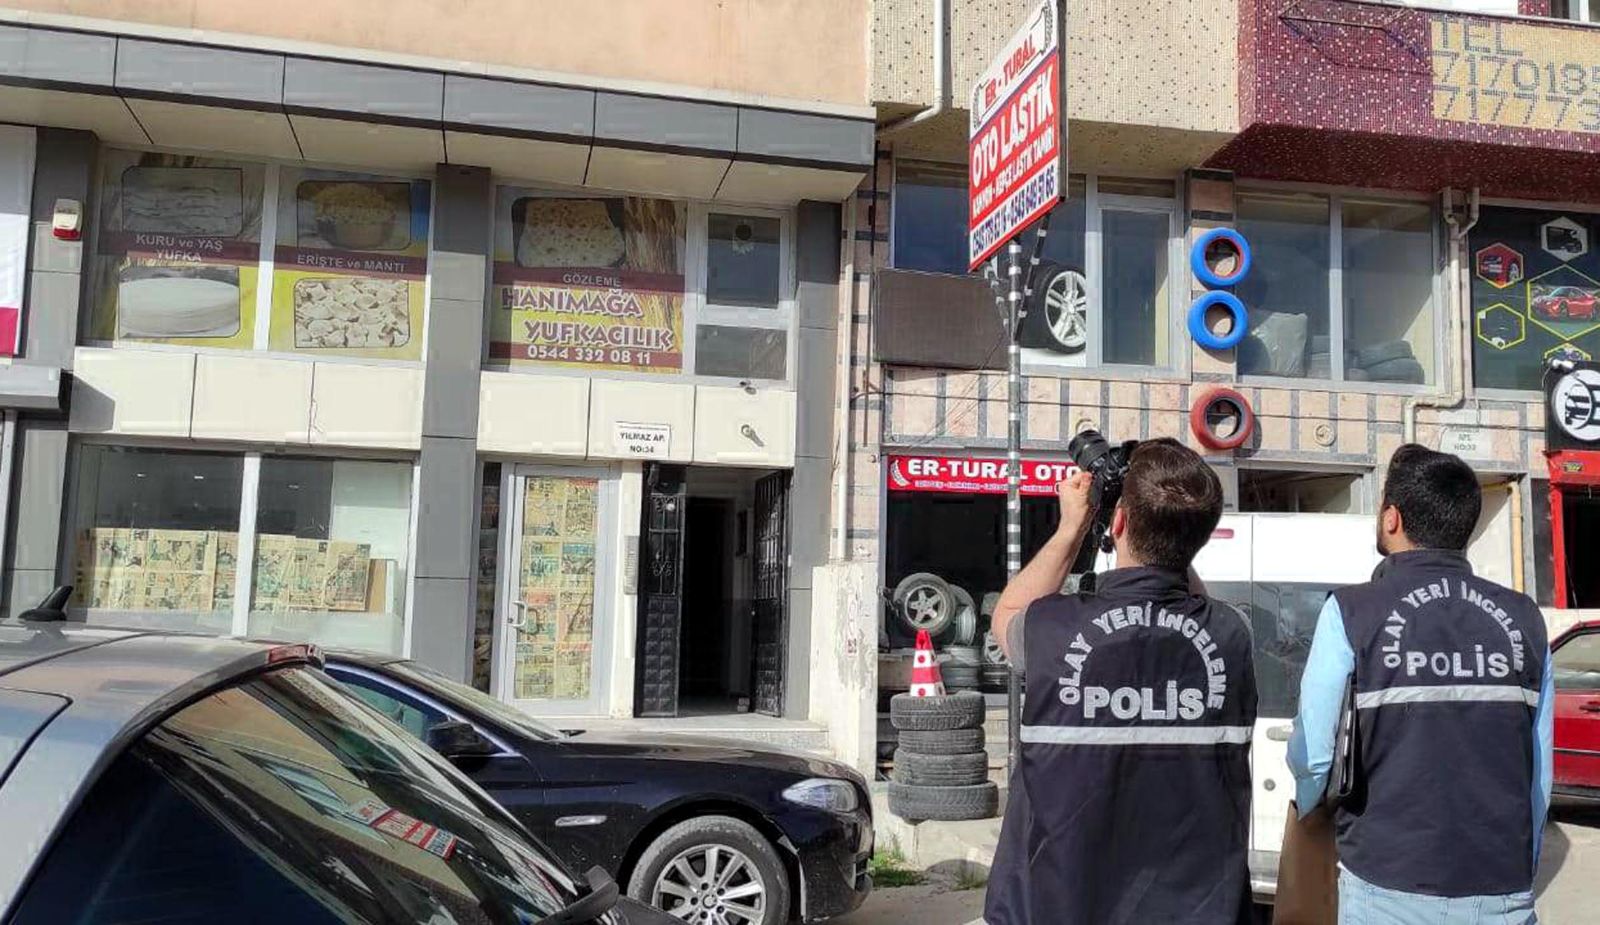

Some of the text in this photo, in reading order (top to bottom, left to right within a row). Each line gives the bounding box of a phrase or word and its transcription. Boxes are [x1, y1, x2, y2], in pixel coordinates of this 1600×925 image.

[1431, 14, 1523, 57] TEL
[985, 78, 997, 109] ER
[1003, 33, 1036, 86] TURAL
[973, 63, 1055, 188] OTO LASTİK
[135, 233, 223, 252] KURU ve YAŞ
[156, 249, 201, 261] YUFKA
[297, 253, 404, 273] ERİŞTE ve MANTI
[562, 272, 622, 288] GÖZLEME
[502, 286, 643, 317] HANIMAĞA
[524, 320, 674, 350] YUFKACILIK
[527, 345, 650, 365] 0544 332 08 11
[1059, 632, 1093, 706] OLAY
[1092, 601, 1152, 635] YERİ
[1382, 609, 1407, 669] OLAY
[1405, 644, 1510, 679] POLİS
[1083, 680, 1205, 720] POLİS
